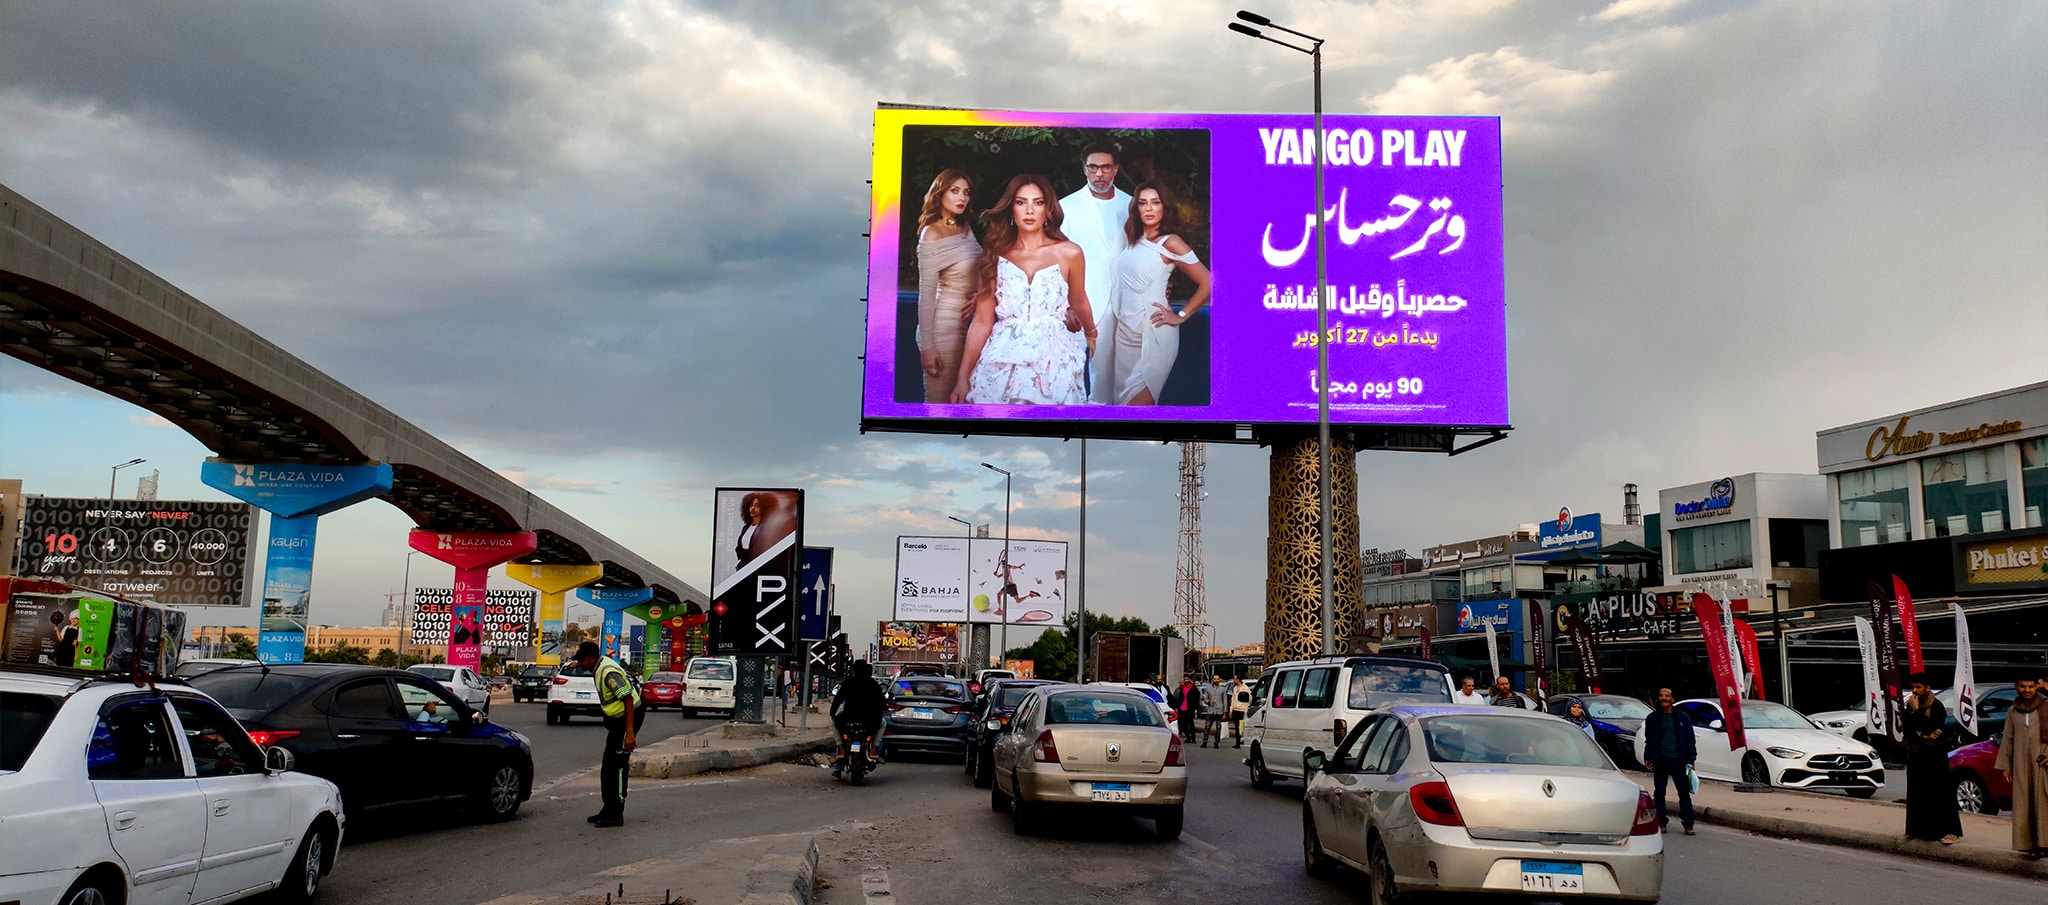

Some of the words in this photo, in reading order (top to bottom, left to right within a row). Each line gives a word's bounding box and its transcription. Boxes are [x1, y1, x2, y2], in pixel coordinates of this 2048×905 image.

[1258, 128, 1374, 166] YANGO
[1382, 130, 1467, 167] PLAY
[1390, 197, 1466, 262] وتر
[1340, 283, 1396, 318] وقبل
[1293, 322, 1342, 348] أكوبر
[1346, 328, 1369, 344] 27
[1372, 329, 1398, 348] من
[1362, 381, 1393, 400] يوم
[1397, 377, 1423, 395] 90
[259, 471, 306, 482] PLAZA
[310, 472, 345, 482] VIDA
[86, 510, 122, 519] NEVER
[124, 510, 146, 519] SAY
[44, 533, 77, 554] 10
[153, 539, 166, 552] 6
[455, 538, 487, 546] PLAZA
[41, 553, 77, 573] years
[1969, 546, 2039, 571] Phuket
[456, 594, 462, 604] 8
[921, 587, 960, 595] BAHJA
[1589, 598, 1601, 619] A
[1609, 592, 1657, 618] PLUS
[1643, 620, 1676, 634] CAFE
[263, 635, 289, 643] PLAZA
